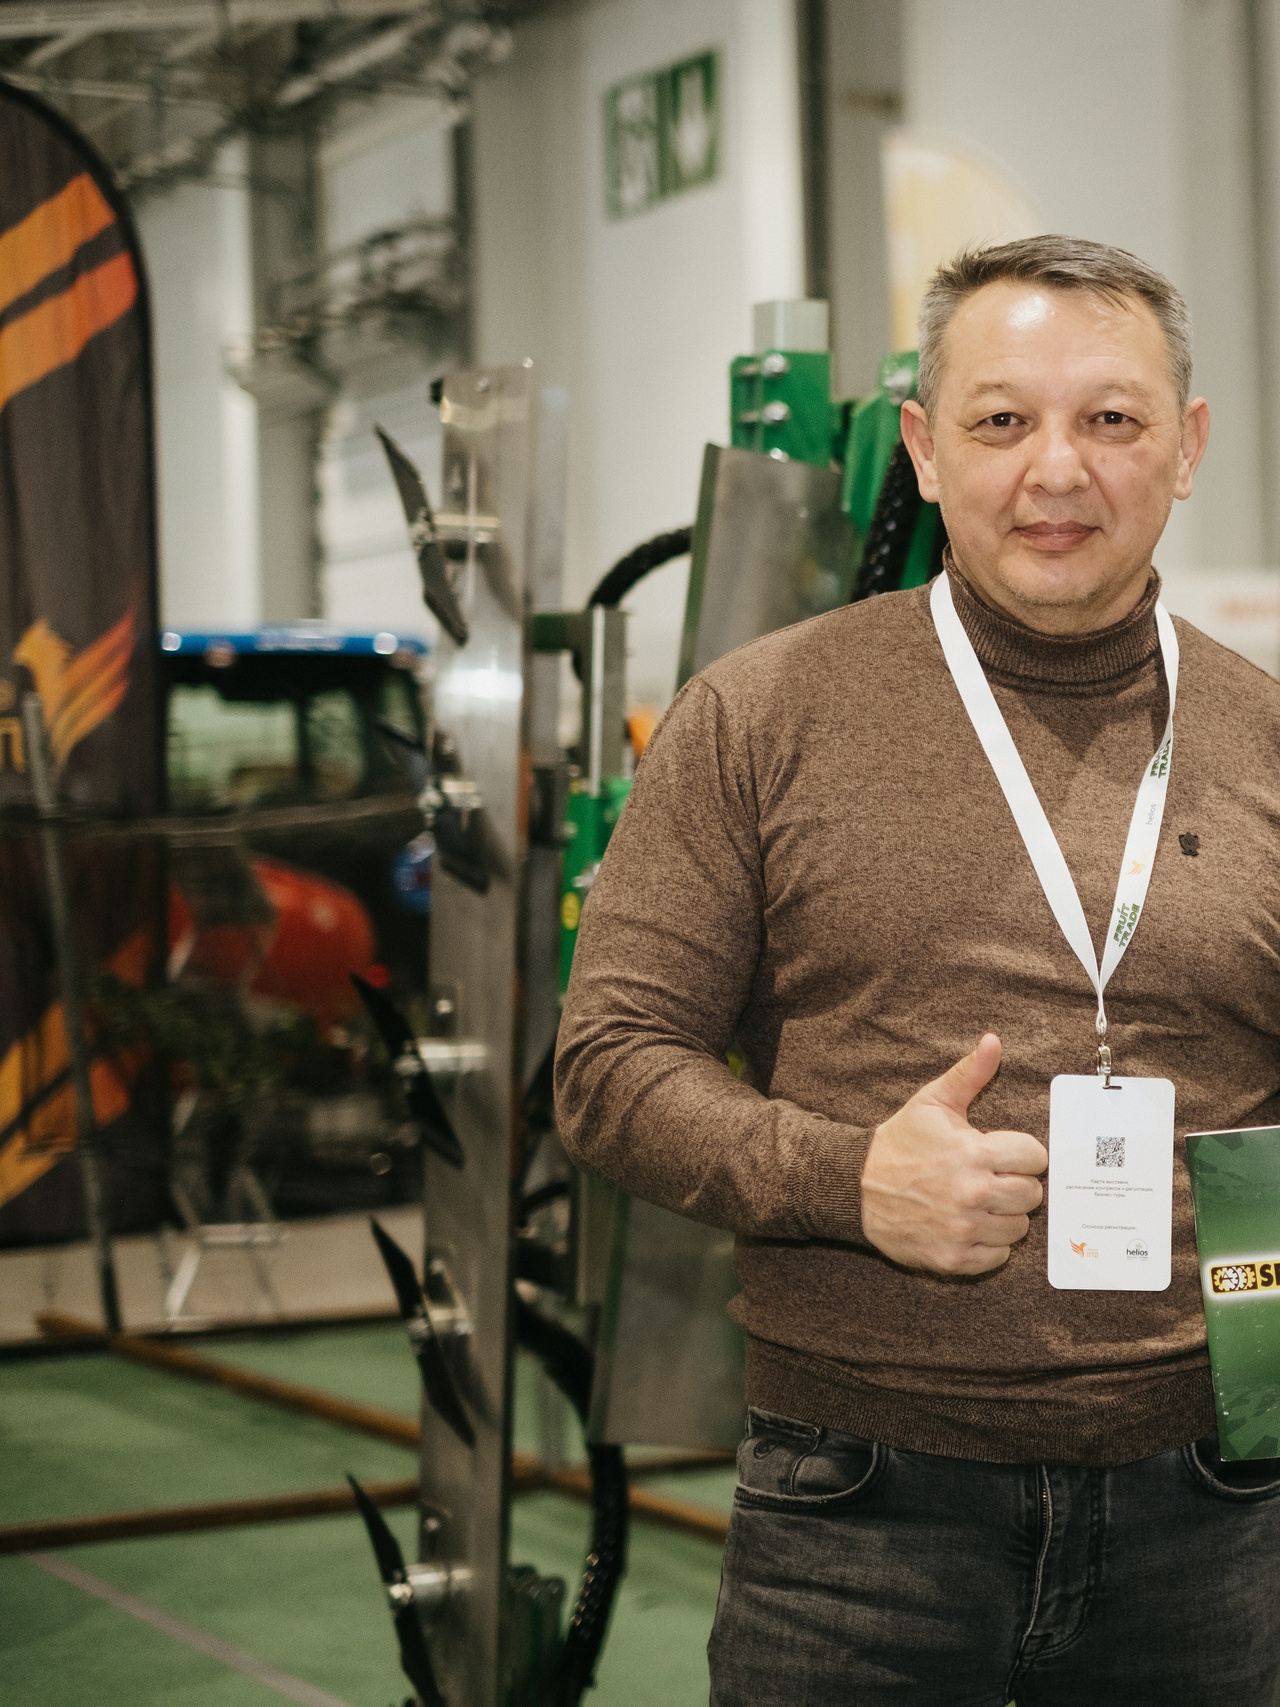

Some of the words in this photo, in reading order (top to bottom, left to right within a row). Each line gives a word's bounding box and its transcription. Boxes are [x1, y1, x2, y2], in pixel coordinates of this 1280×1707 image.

[1113, 903, 1130, 942] FRUIT
[1119, 903, 1140, 947] TRADE
[1126, 1248, 1148, 1256] helios
